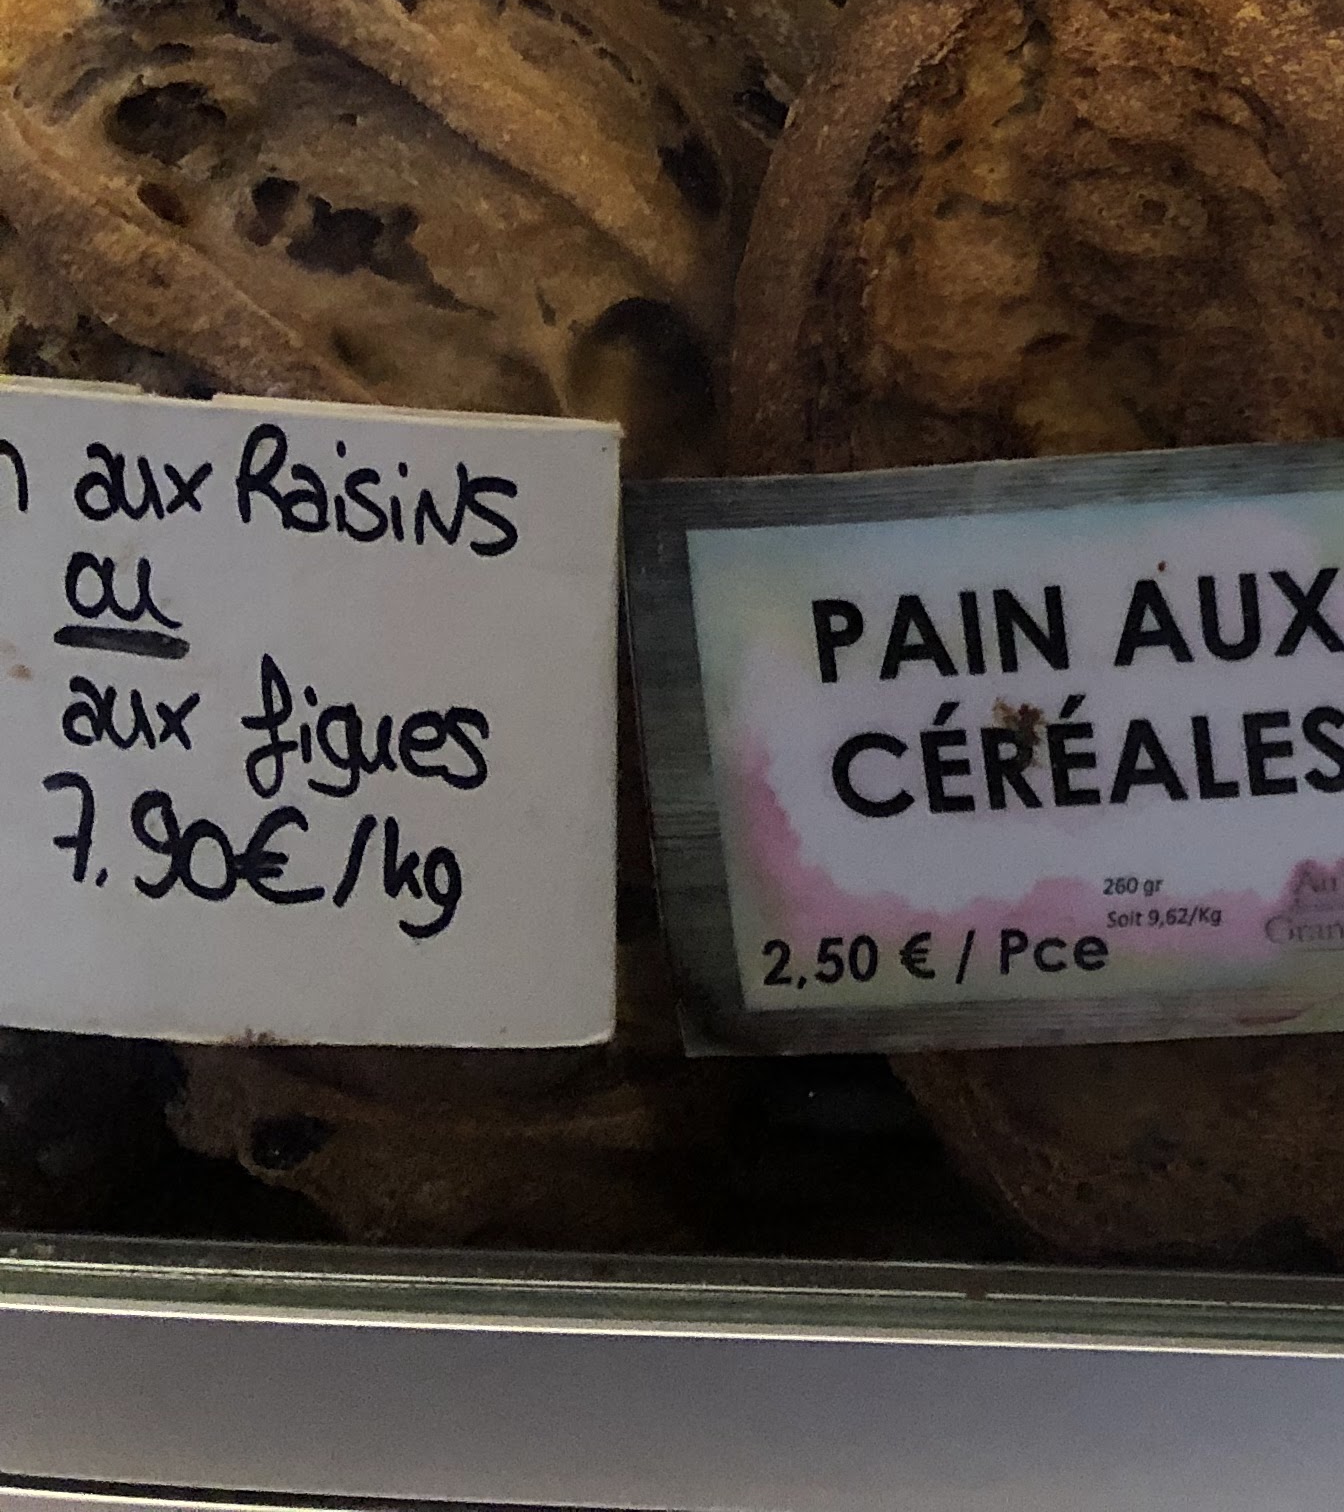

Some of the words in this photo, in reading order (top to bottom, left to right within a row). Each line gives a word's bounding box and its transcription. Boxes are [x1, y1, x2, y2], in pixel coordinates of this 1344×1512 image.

[74, 442, 213, 521] aux
[61, 551, 184, 633] ou
[812, 585, 1069, 683] PAIN
[62, 676, 200, 750] aux
[241, 653, 489, 799] figues
[1103, 877, 1139, 895] 260
[1143, 879, 1163, 897] gr
[1107, 911, 1142, 928] Soit
[763, 938, 878, 990] 2,50
[899, 932, 935, 979] €
[956, 930, 975, 984] /
[1000, 930, 1108, 975] Pce
